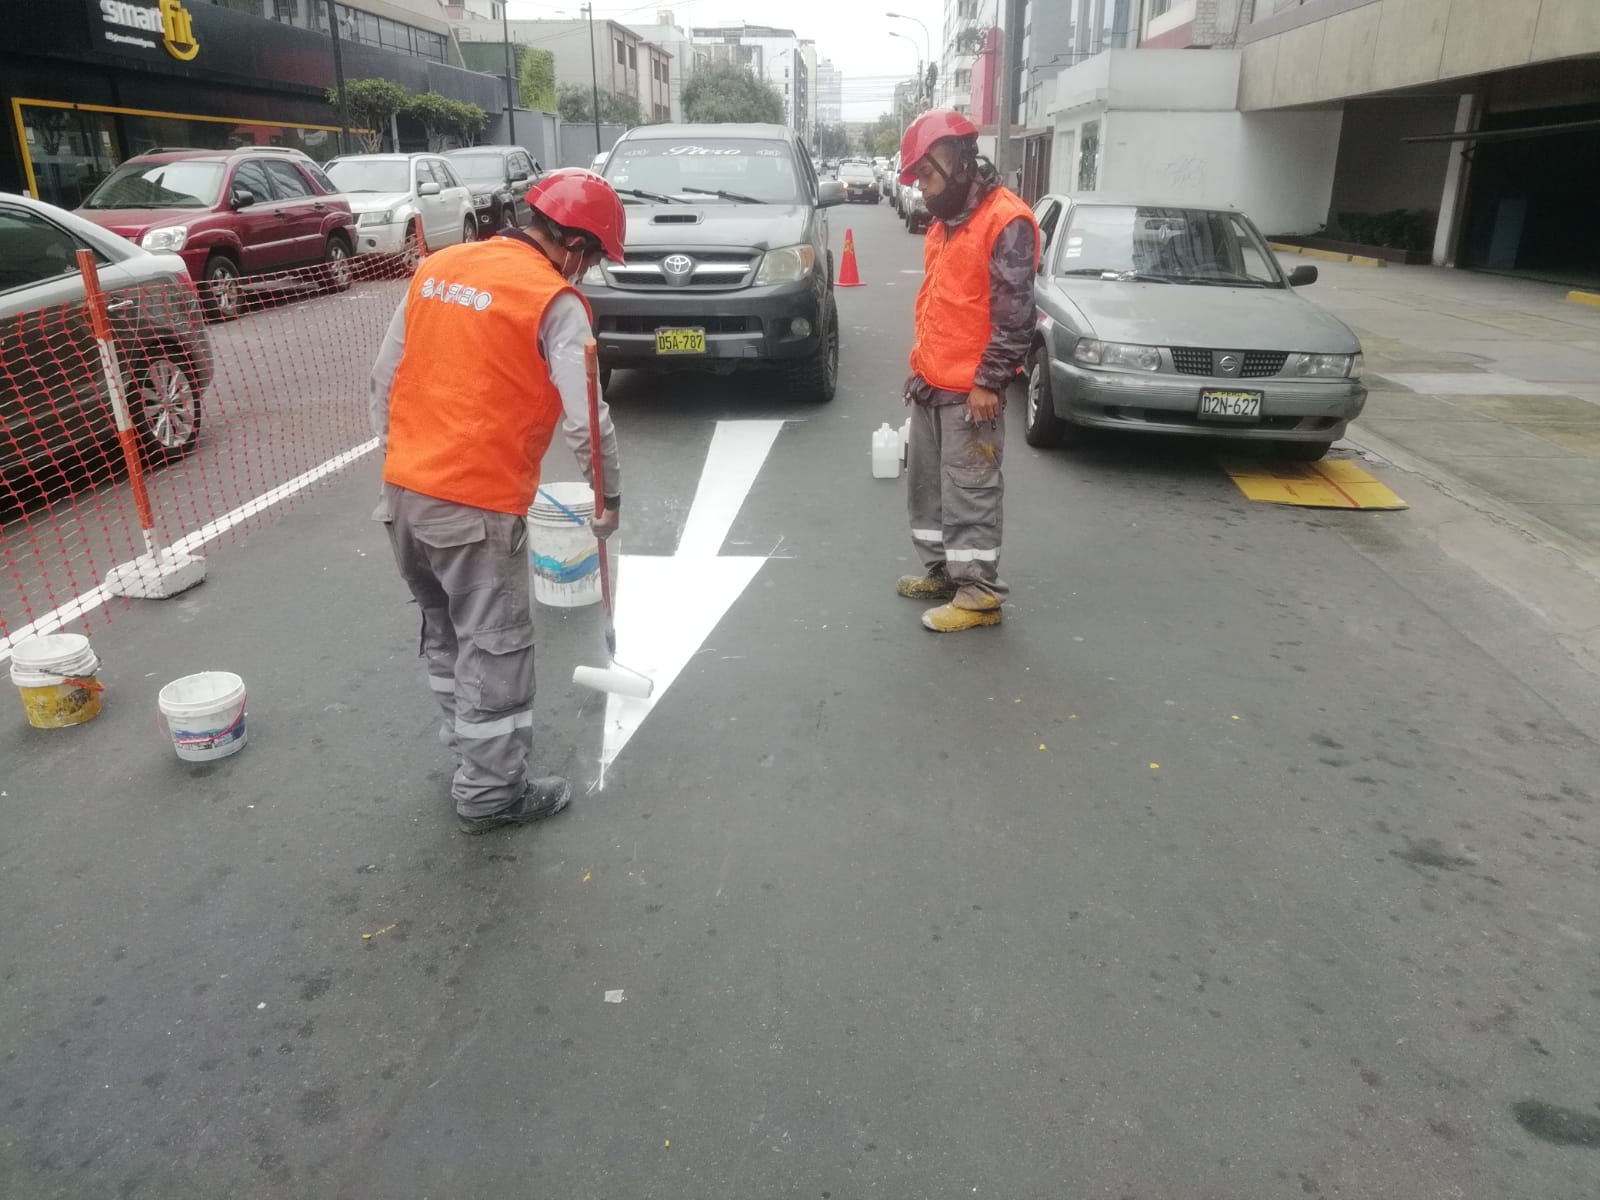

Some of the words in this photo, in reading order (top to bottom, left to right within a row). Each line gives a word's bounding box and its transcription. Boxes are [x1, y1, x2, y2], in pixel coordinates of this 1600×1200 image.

[100, 0, 165, 33] smart
[159, 0, 197, 46] fit
[659, 335, 703, 350] D5A-787
[1203, 396, 1259, 416] D2N-627
